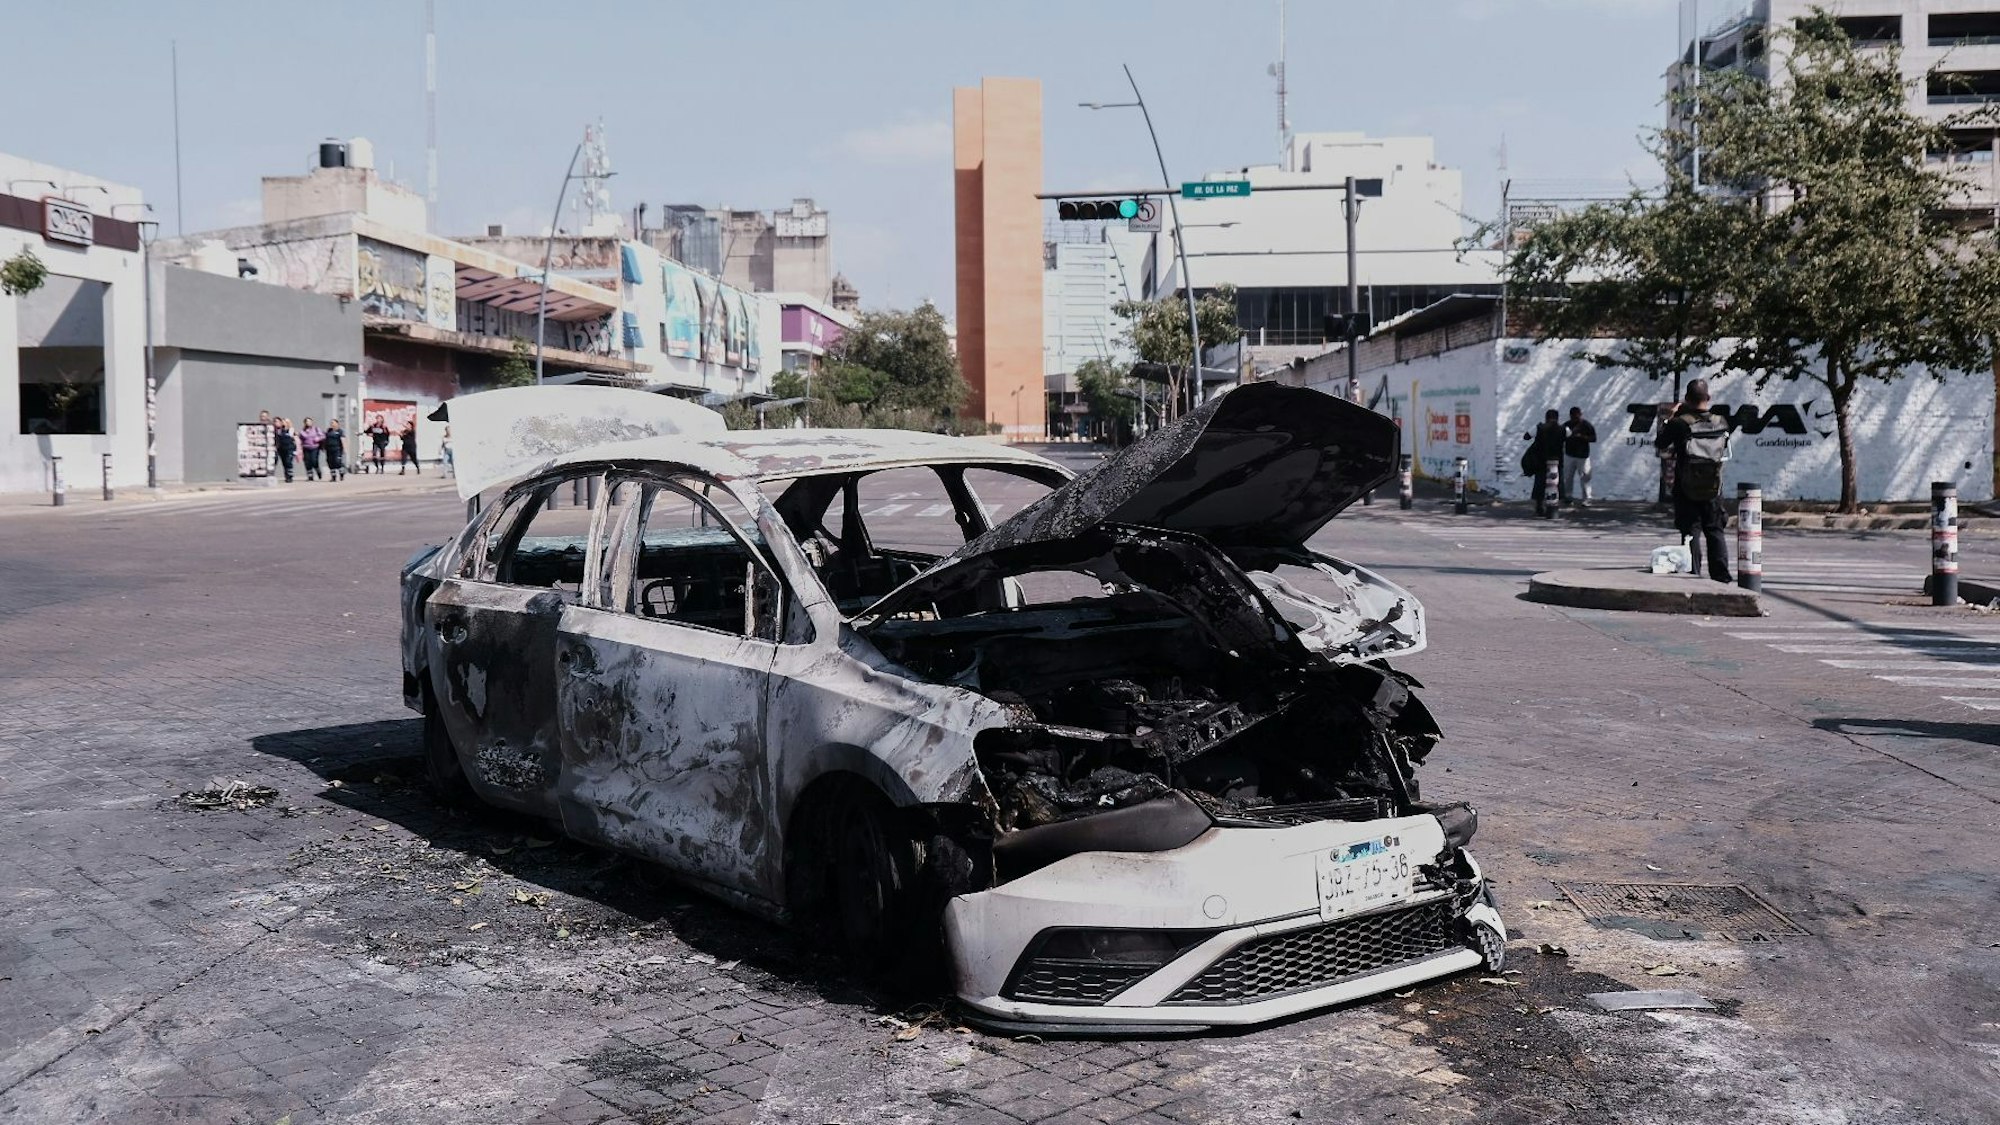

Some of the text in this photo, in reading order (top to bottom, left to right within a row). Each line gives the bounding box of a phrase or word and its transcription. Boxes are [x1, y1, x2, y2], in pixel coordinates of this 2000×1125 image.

[1206, 186, 1214, 195] DE
[1216, 185, 1224, 194] LA
[1227, 185, 1239, 194] PAZ
[1755, 437, 1812, 449] Guadalajara
